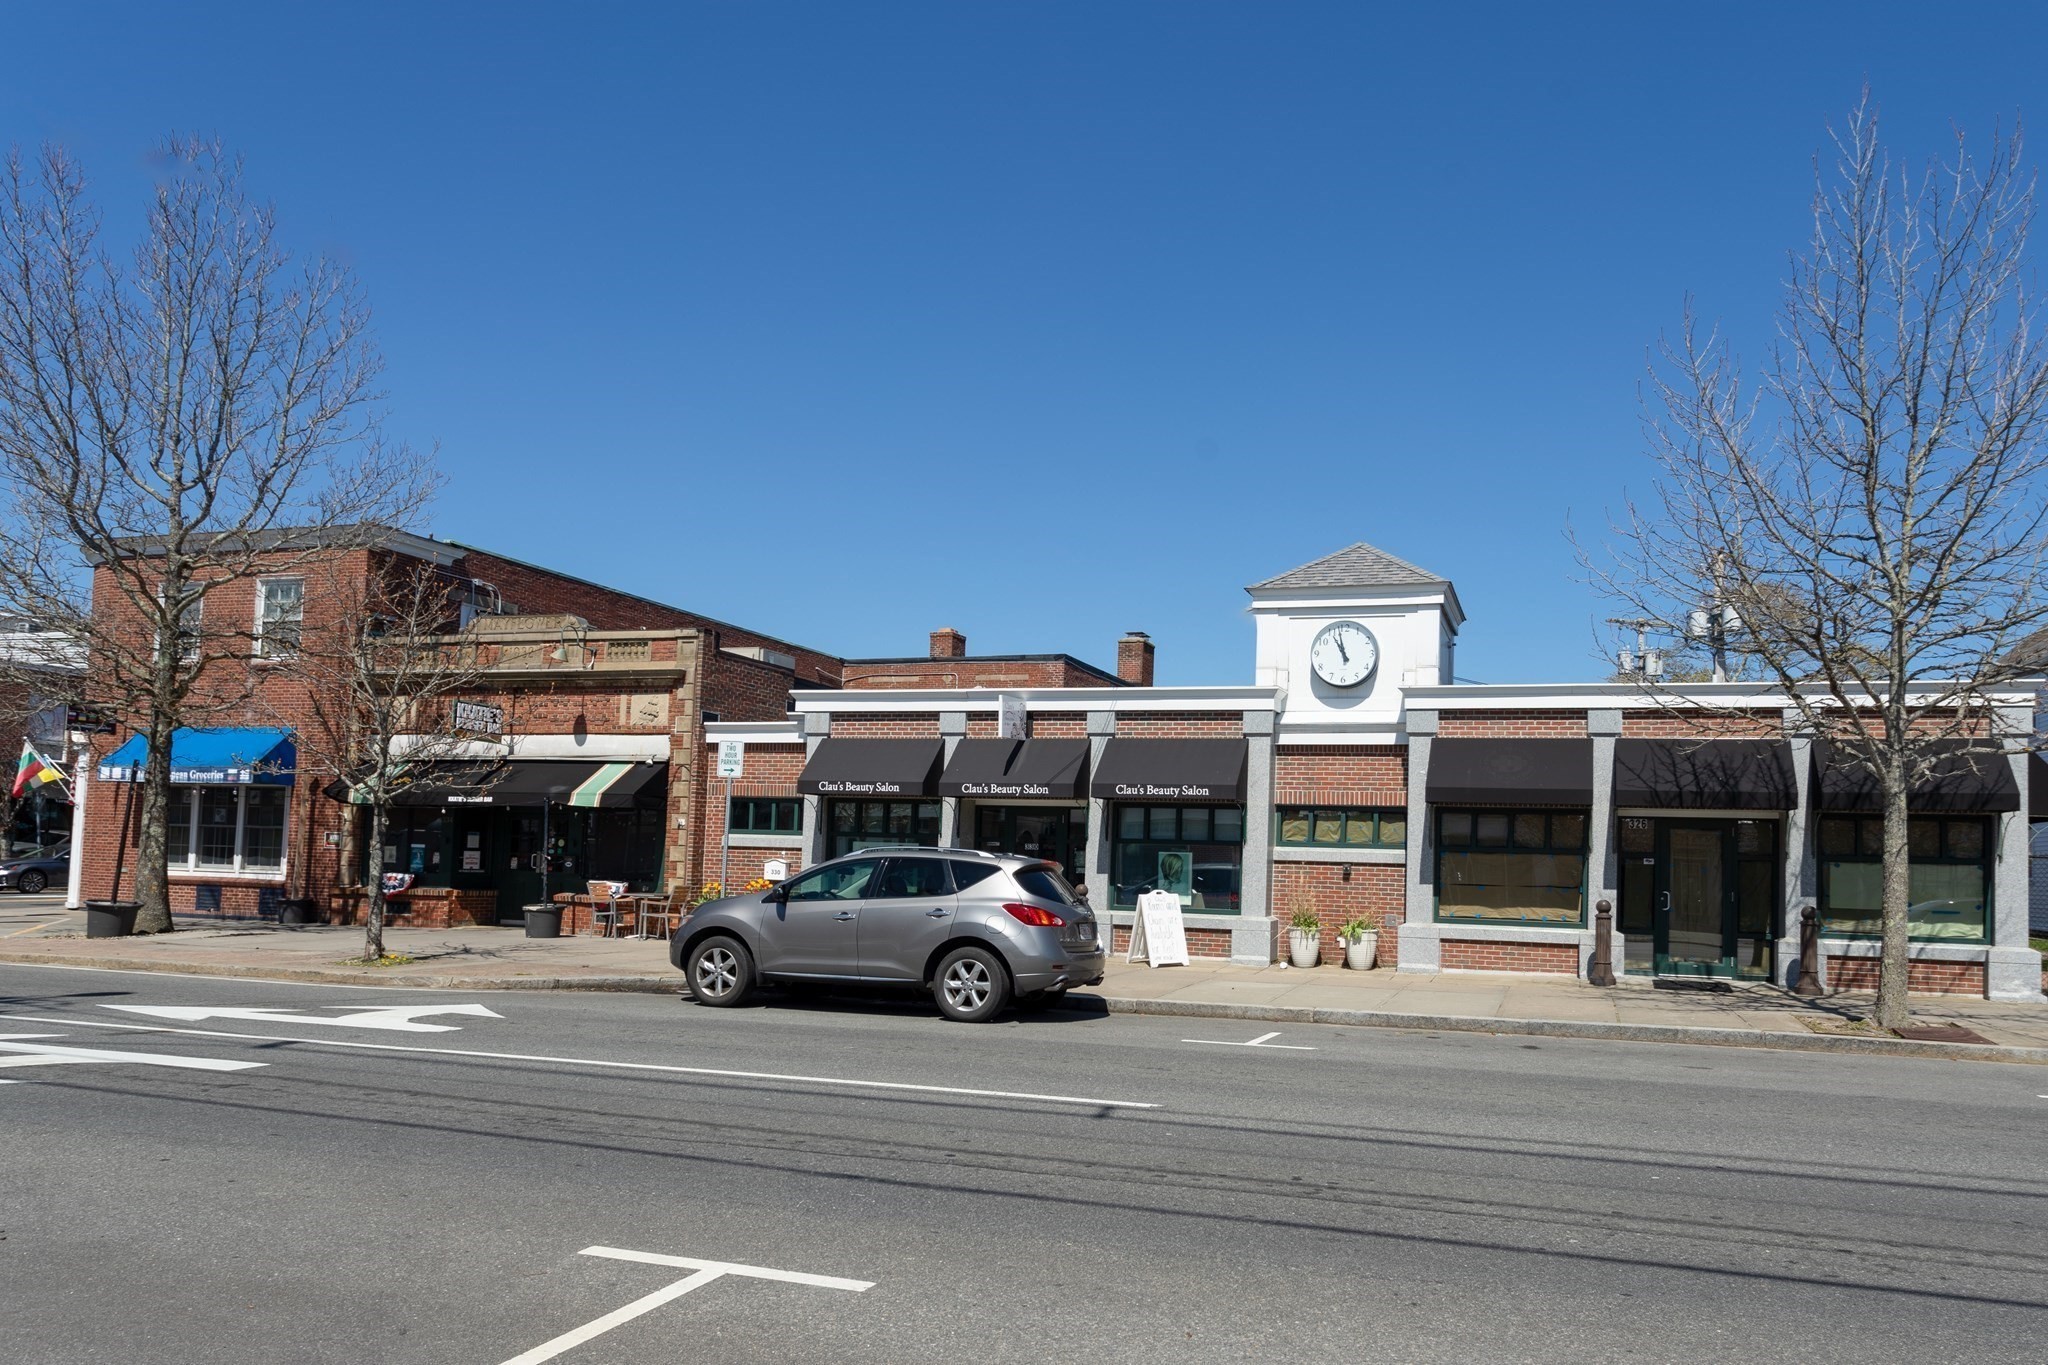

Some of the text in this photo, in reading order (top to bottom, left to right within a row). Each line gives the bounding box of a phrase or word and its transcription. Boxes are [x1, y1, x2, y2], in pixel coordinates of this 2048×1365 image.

[483, 617, 563, 630] MAYFLOWER
[1341, 624, 1350, 632] 12
[1318, 638, 1329, 646] 10
[1365, 636, 1370, 644] 2
[1318, 663, 1323, 671] 8
[1363, 663, 1369, 671] 4
[1329, 672, 1334, 681] 7
[1353, 672, 1359, 681] 5
[189, 769, 224, 780] Groceries
[818, 781, 900, 794] Clau's Beauty Salon
[961, 783, 1049, 796] Clau's Beauty Salon
[1115, 784, 1209, 797] Clau's Beauty Salon
[1630, 819, 1647, 828] 326
